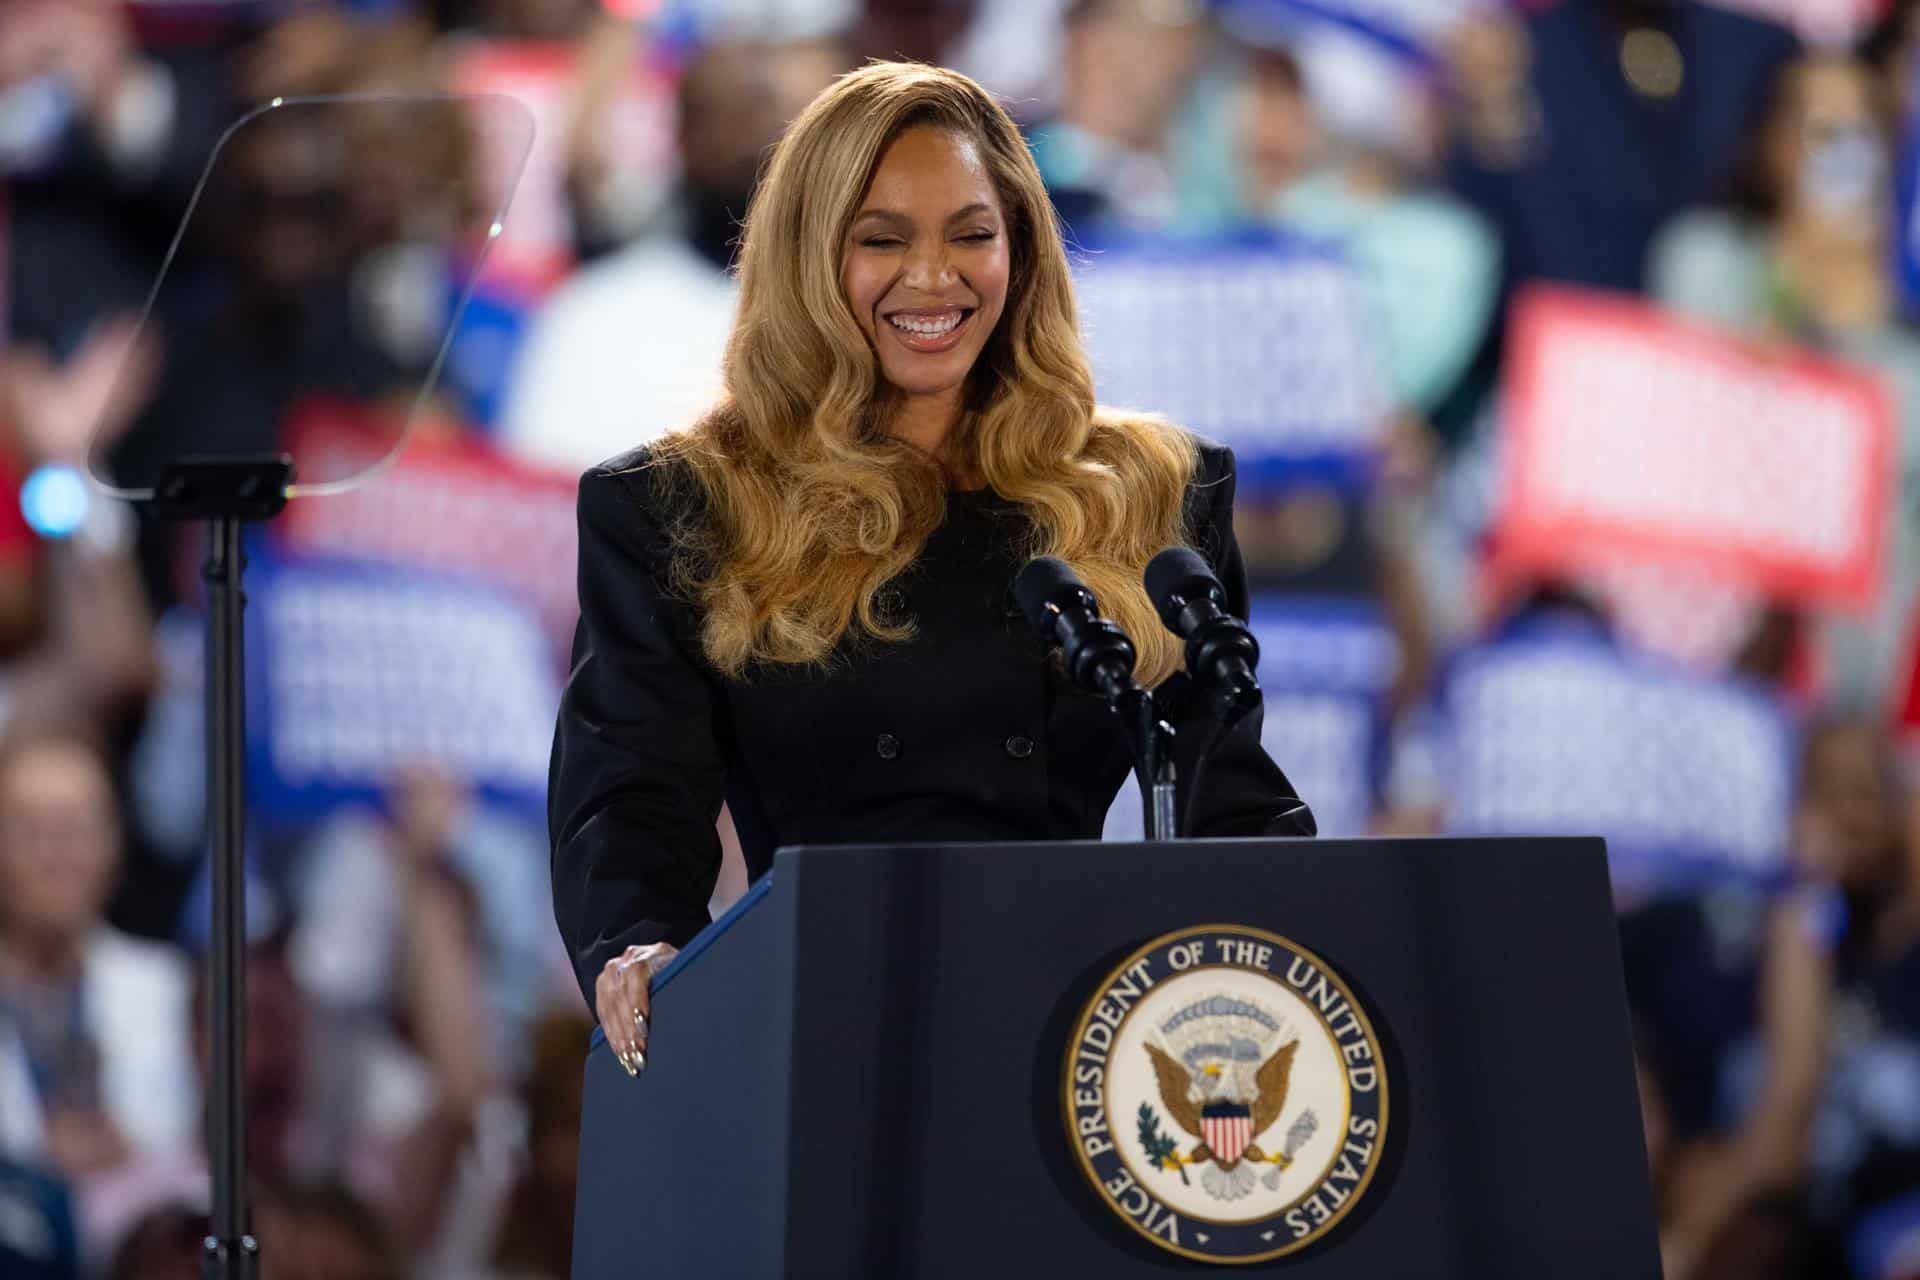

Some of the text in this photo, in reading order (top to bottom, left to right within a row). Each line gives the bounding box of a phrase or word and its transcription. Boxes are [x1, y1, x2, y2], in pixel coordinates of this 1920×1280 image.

[1075, 939, 1377, 1245] VICE PRESIDENT OF THE UNITED STATES
